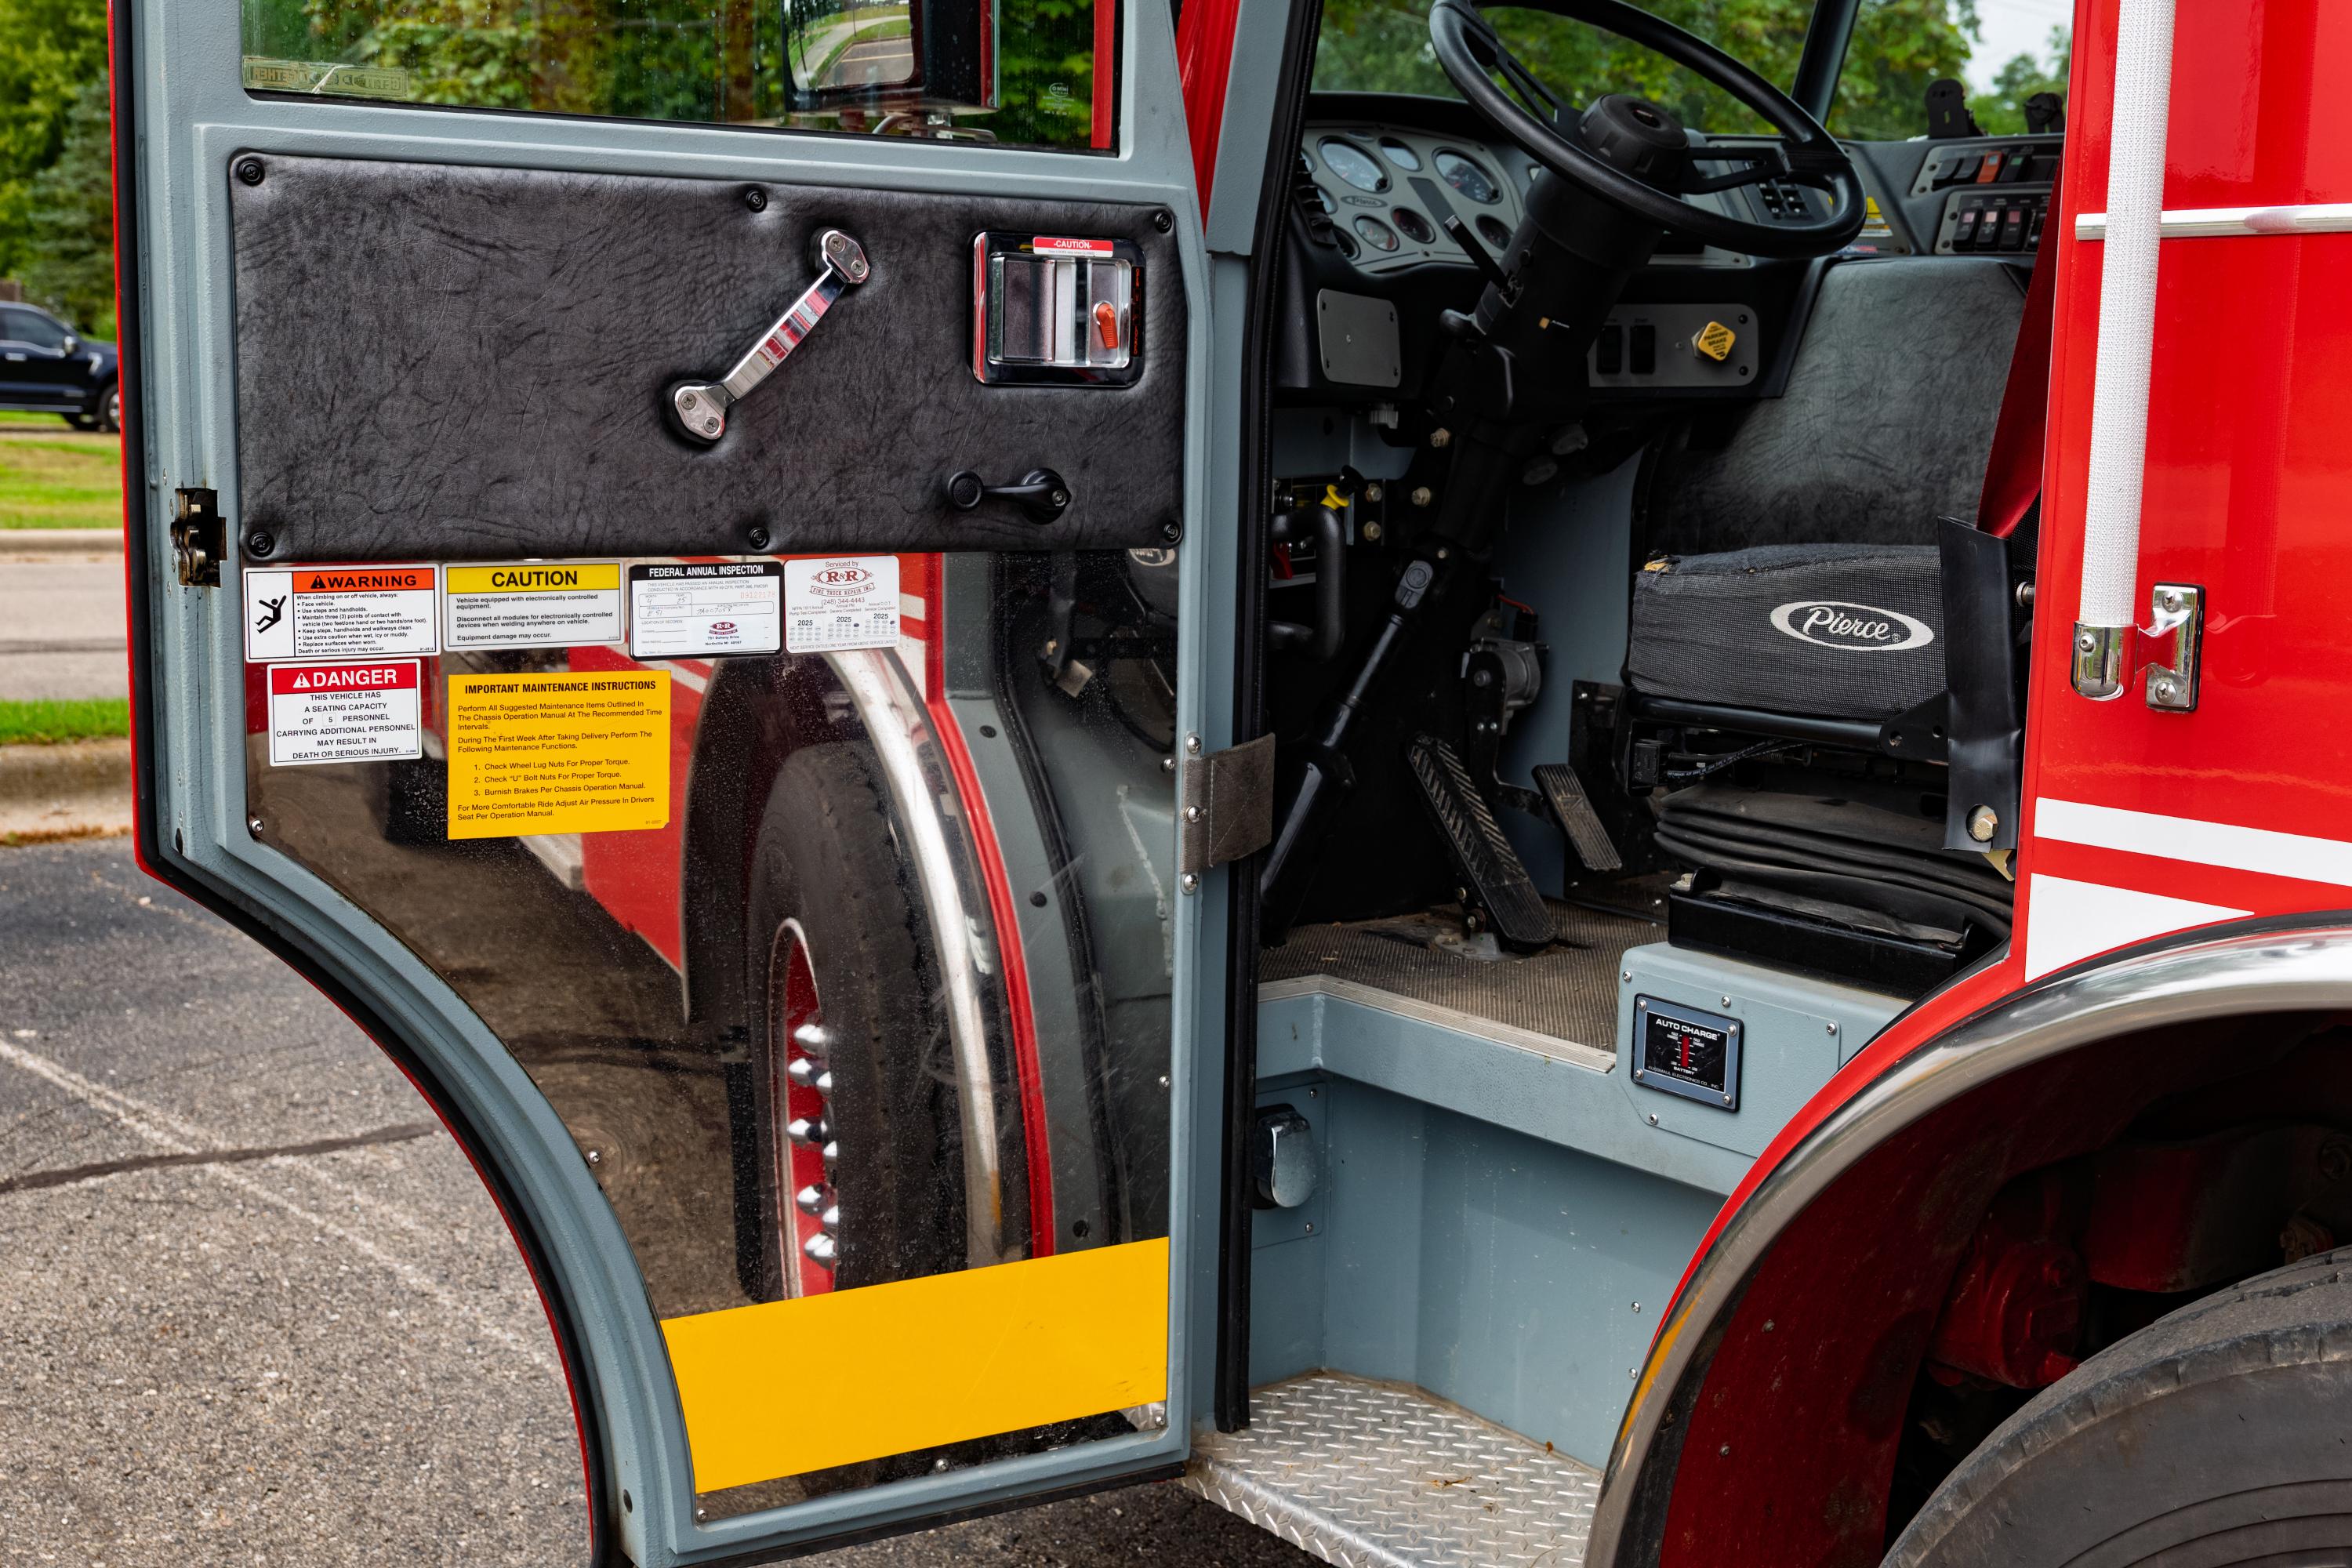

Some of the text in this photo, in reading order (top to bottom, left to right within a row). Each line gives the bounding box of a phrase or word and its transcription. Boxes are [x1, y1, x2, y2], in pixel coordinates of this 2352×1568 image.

[648, 564, 763, 576] FEDERAL ANNUAL INSPECTION
[327, 575, 416, 587] WARNING
[491, 571, 577, 586] CAUTION
[826, 571, 858, 583] R&R
[1803, 606, 1890, 641] Pierce
[313, 669, 397, 686] DANGER
[465, 681, 655, 693] IMPORTANT MAINTENANCE INSTRUCTIONS
[321, 750, 332, 759] OR
[335, 749, 368, 758] SERIOUS
[371, 747, 401, 756] INJURY.
[1656, 1018, 1679, 1029] AUTO
[1681, 1025, 1718, 1040] CHARGE
[1673, 1066, 1695, 1075] BATTERY
[1672, 1073, 1700, 1084] ELECTRONICS
